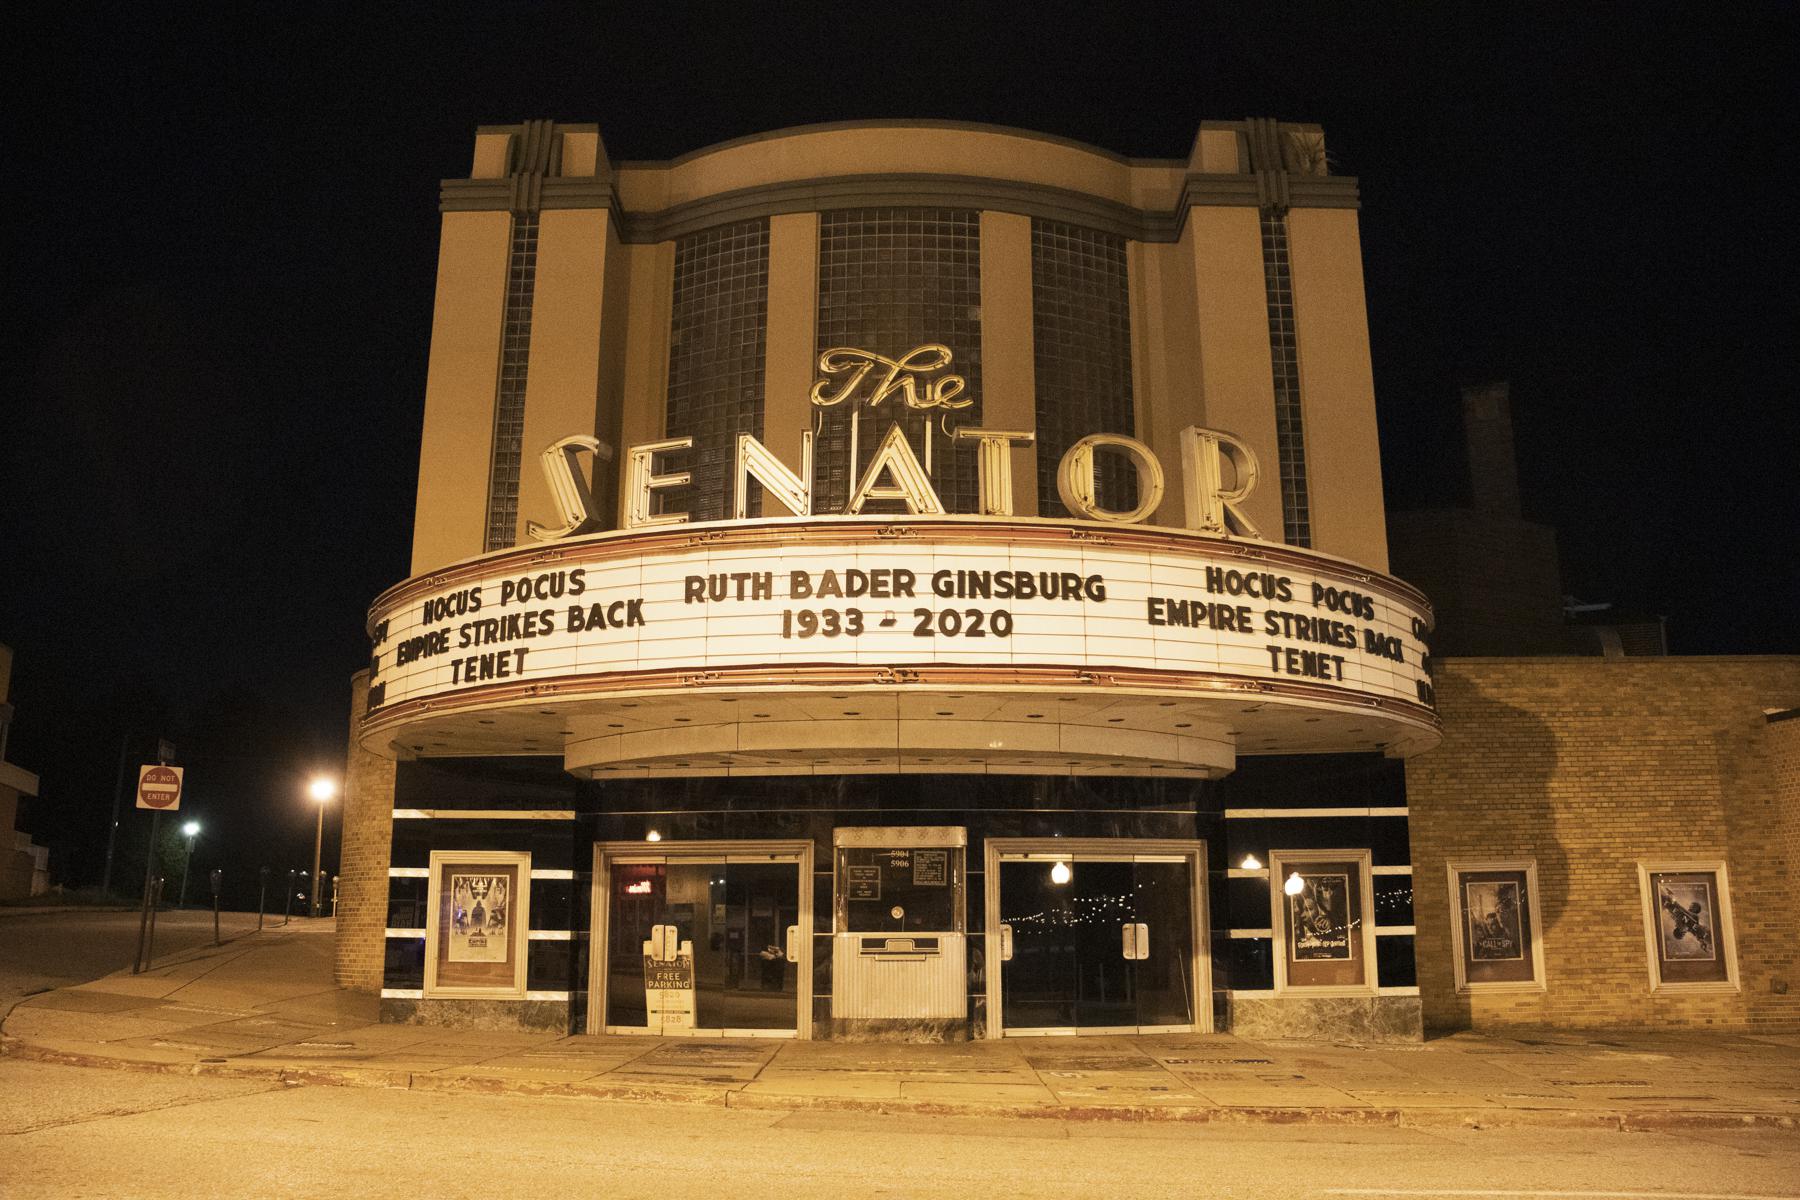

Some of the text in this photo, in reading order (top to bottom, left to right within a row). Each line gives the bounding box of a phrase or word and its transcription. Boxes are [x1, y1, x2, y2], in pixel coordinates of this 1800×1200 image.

[809, 343, 974, 409] The
[527, 421, 1262, 541] SENATOR
[423, 568, 586, 626] HOCUS POCUS
[685, 568, 1106, 603] RUTH BADER GINSBURG
[1205, 566, 1375, 621] HOCUS POCUS
[397, 598, 645, 667] EMPIRE STRIKES BACK
[783, 608, 865, 639] 1933
[913, 608, 1014, 638] 2020
[1147, 597, 1253, 634] EMPIRE
[1265, 609, 1357, 649] STRIKES
[1364, 628, 1404, 664] BACK
[451, 647, 529, 684] TENET
[1266, 645, 1344, 682] TENET
[146, 774, 157, 782] DO
[147, 793, 170, 801] ENTER
[891, 860, 909, 868] 5906
[648, 980, 690, 989] PARKING
[656, 972, 680, 981] FREE
